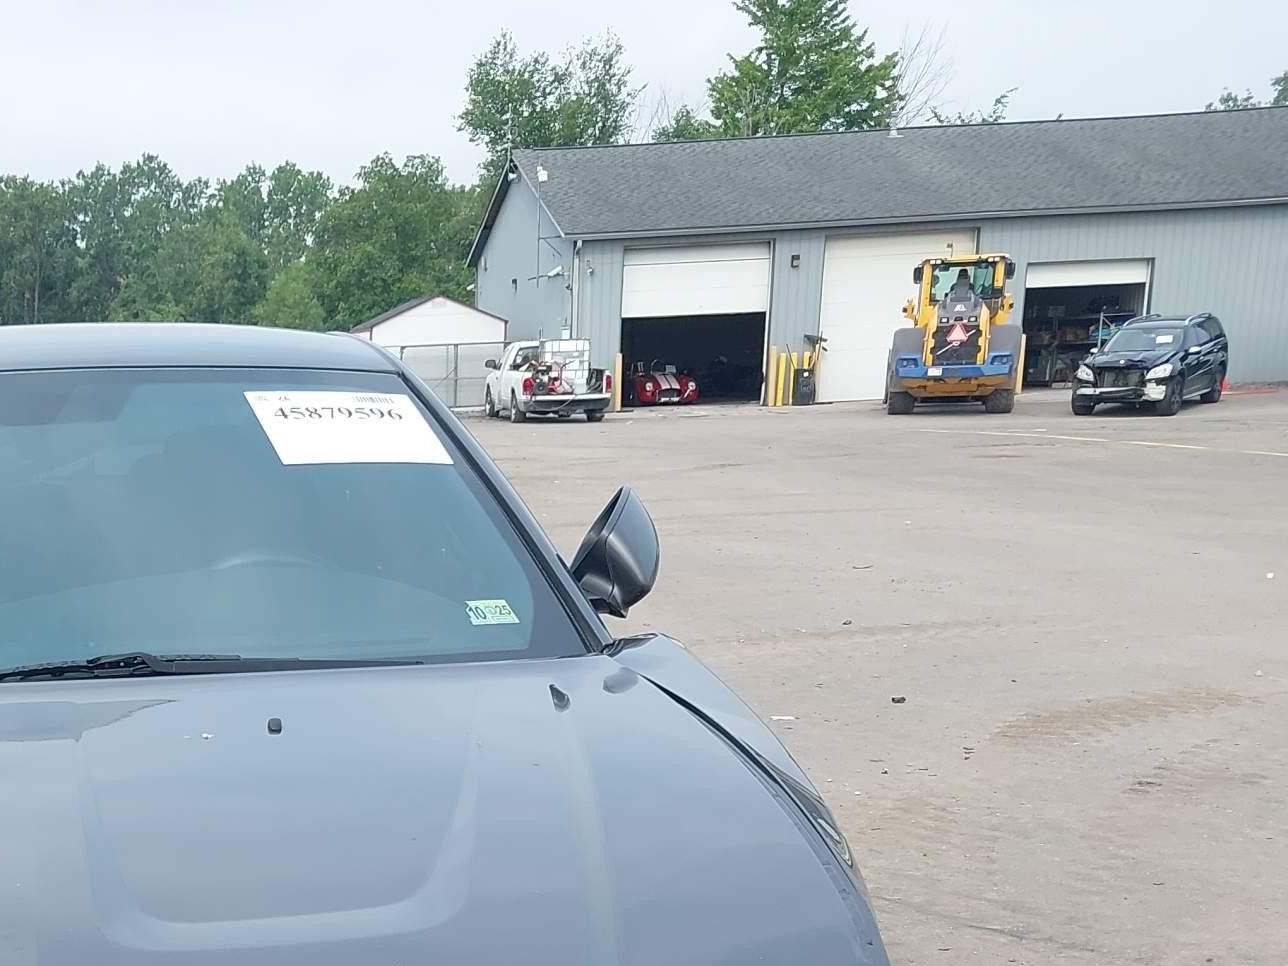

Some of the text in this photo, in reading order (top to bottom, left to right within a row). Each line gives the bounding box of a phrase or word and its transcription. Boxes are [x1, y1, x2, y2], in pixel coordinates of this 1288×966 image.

[273, 406, 404, 421] 45879596
[468, 604, 512, 621] 10 25
